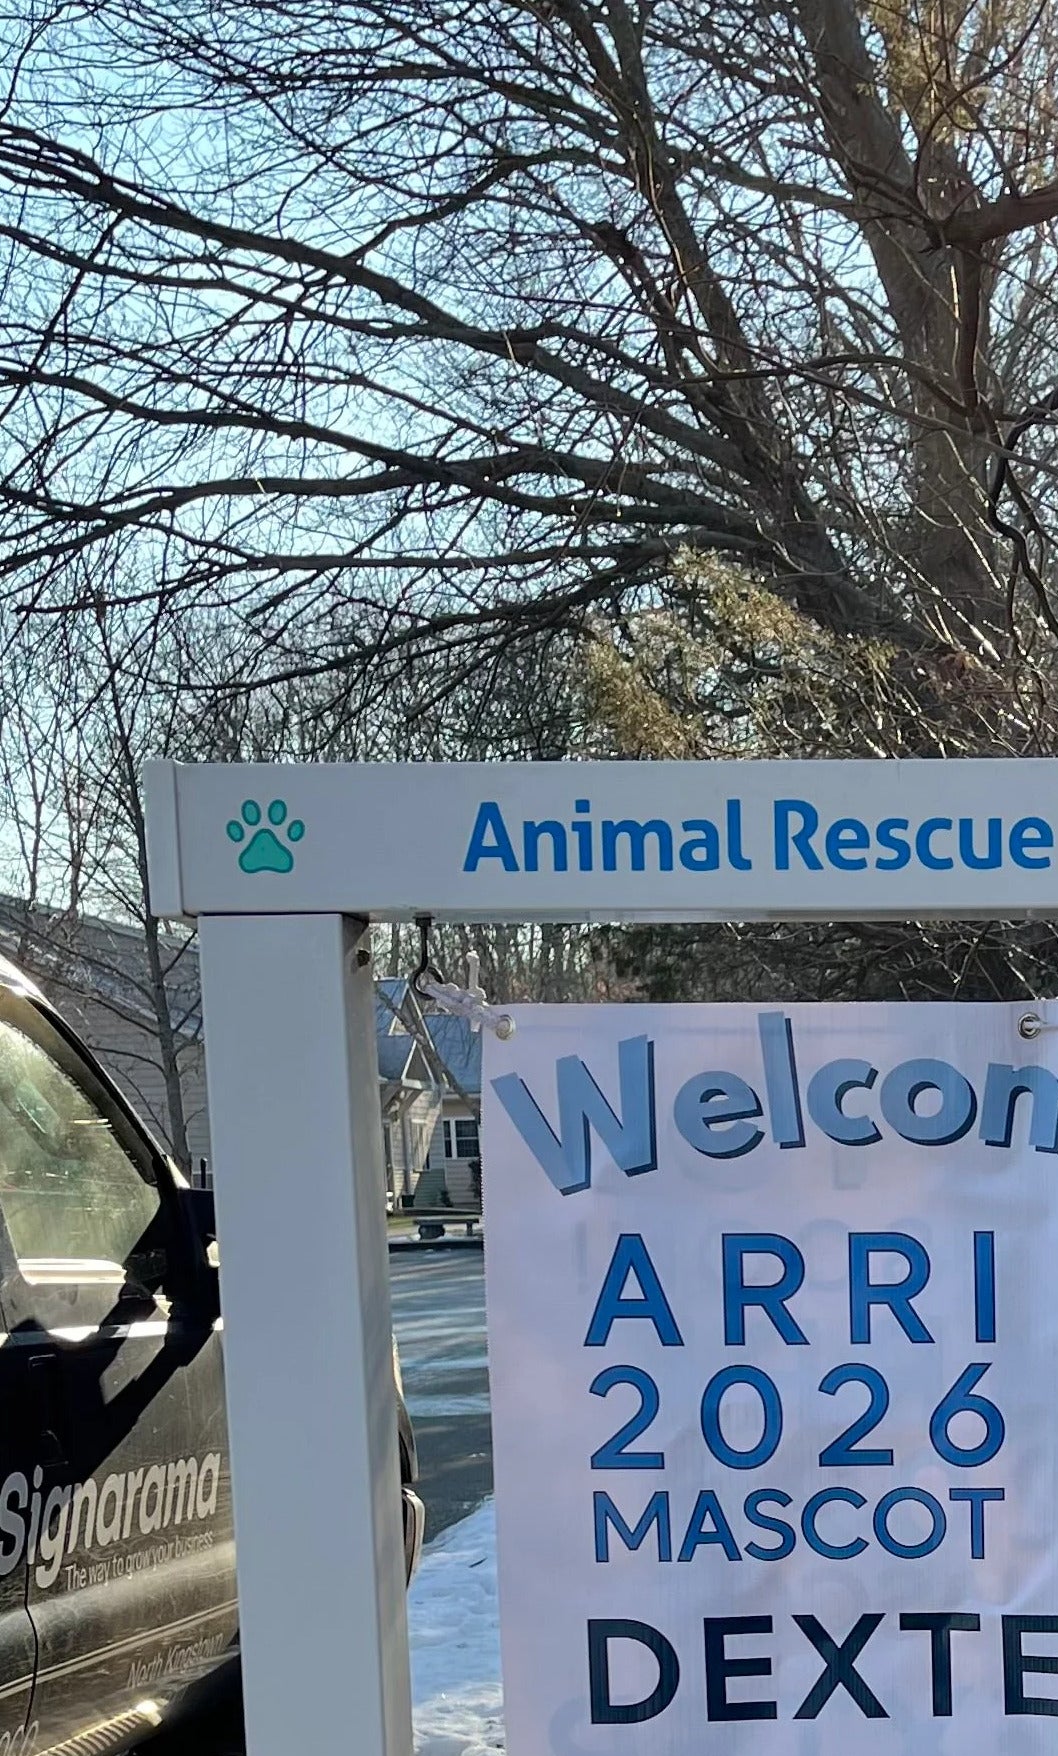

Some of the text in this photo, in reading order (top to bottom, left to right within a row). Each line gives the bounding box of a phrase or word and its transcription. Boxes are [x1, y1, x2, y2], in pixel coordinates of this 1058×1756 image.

[462, 798, 753, 874] Animal
[773, 799, 1054, 872] Rescue
[583, 1230, 997, 1348] ARRI
[588, 1361, 1006, 1471] 2026
[0, 1450, 222, 1589] Signarama
[592, 1486, 1005, 1563] MASCOT
[64, 1529, 215, 1591] The way to grow your business
[127, 1651, 164, 1689] North
